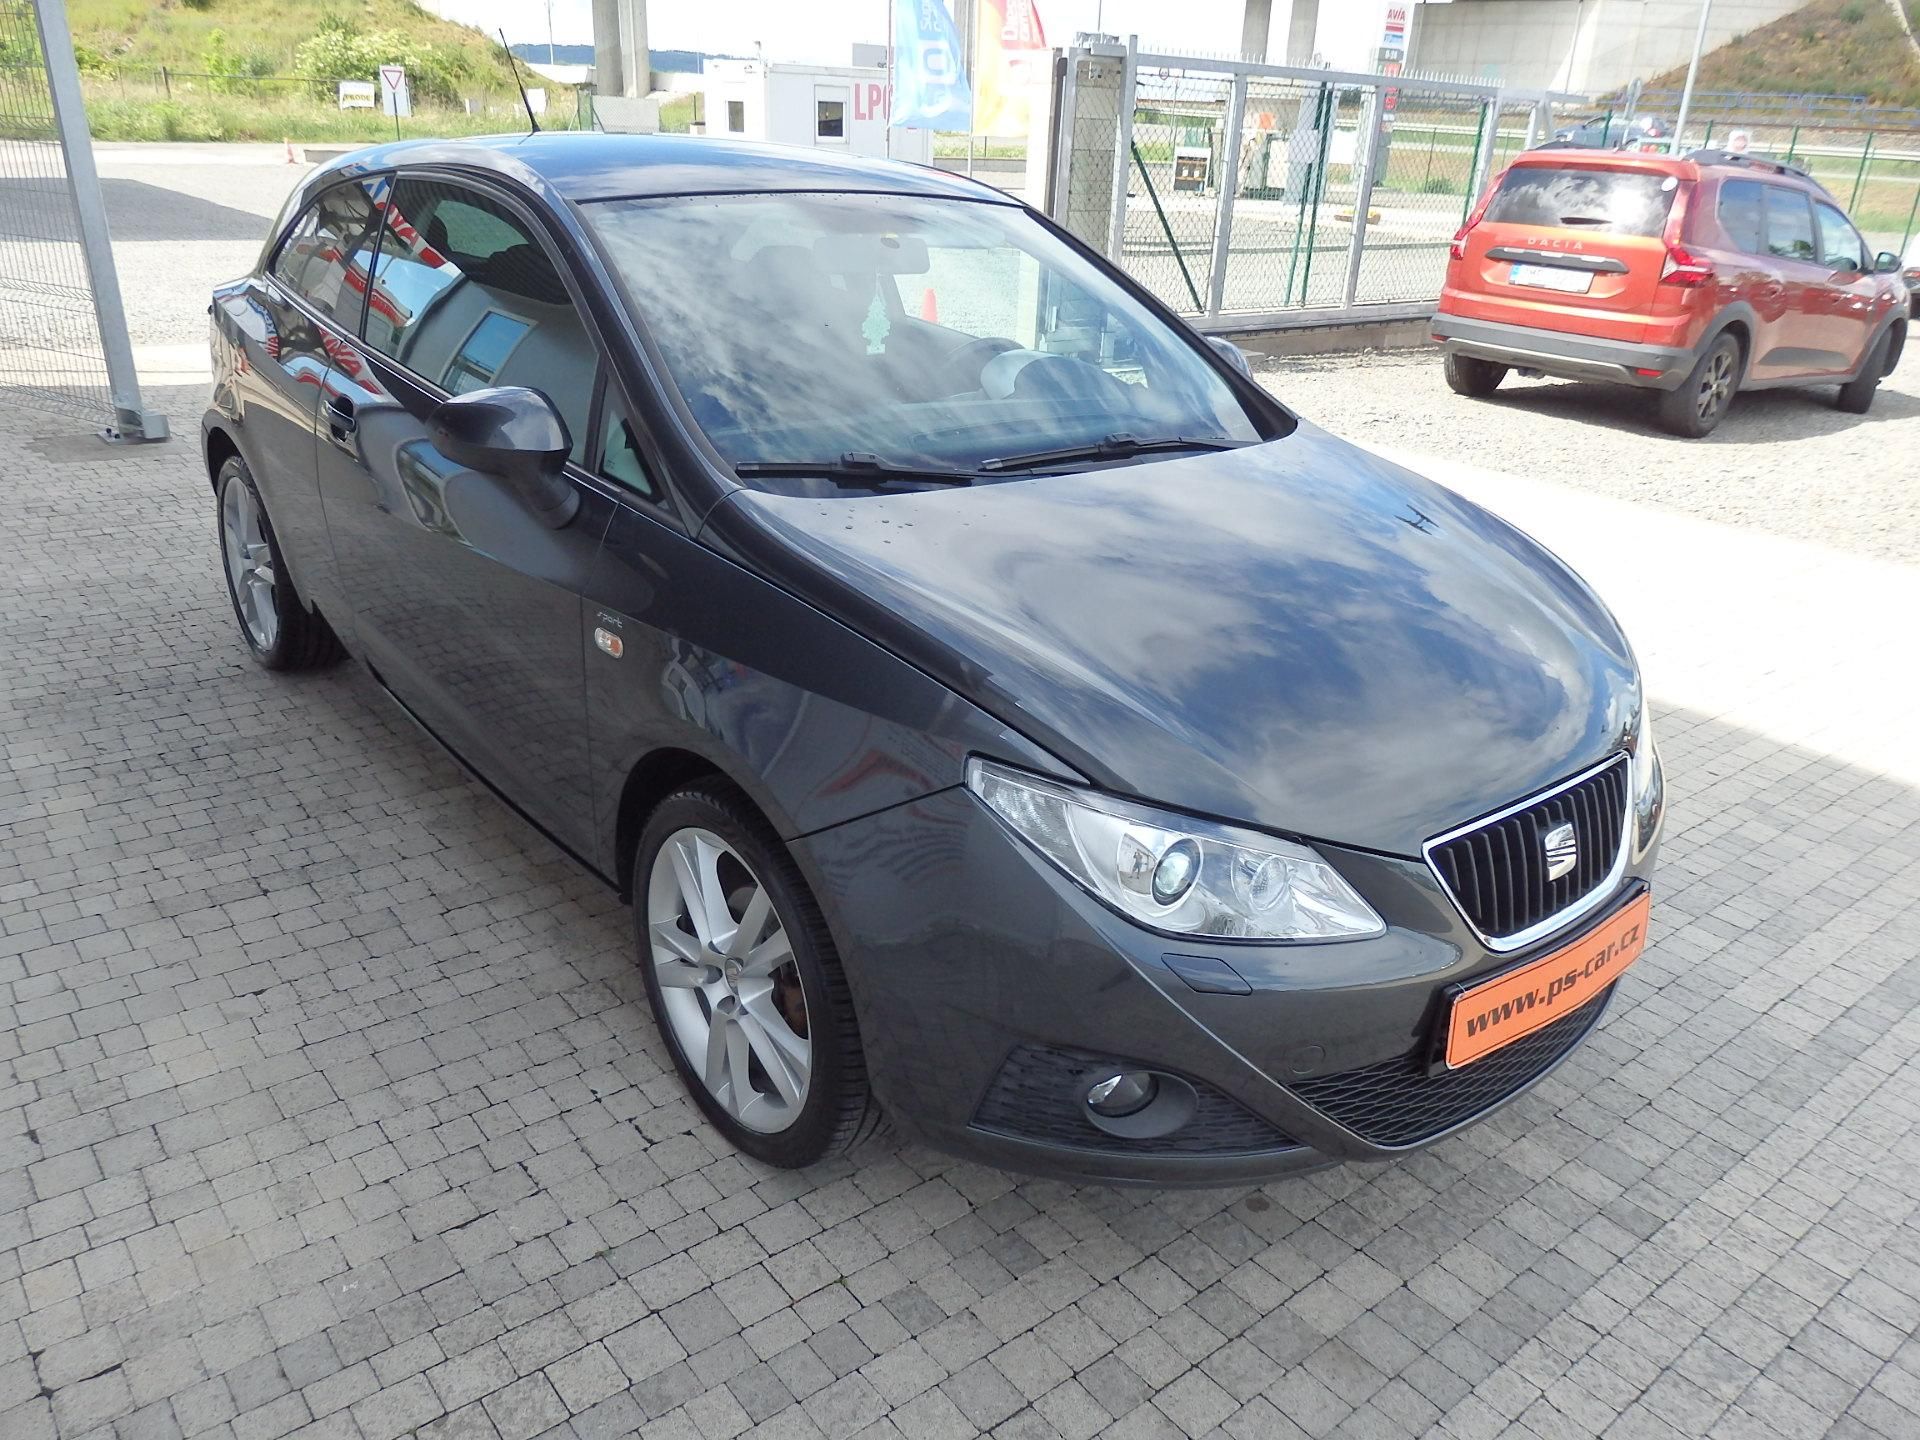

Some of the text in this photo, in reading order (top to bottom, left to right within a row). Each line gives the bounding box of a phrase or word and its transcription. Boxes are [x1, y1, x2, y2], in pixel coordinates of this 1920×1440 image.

[1387, 8, 1405, 22] AVIA
[1527, 237, 1583, 249] DACIA
[597, 611, 623, 628] sport
[1466, 923, 1640, 1038] www.ps-car.cz
